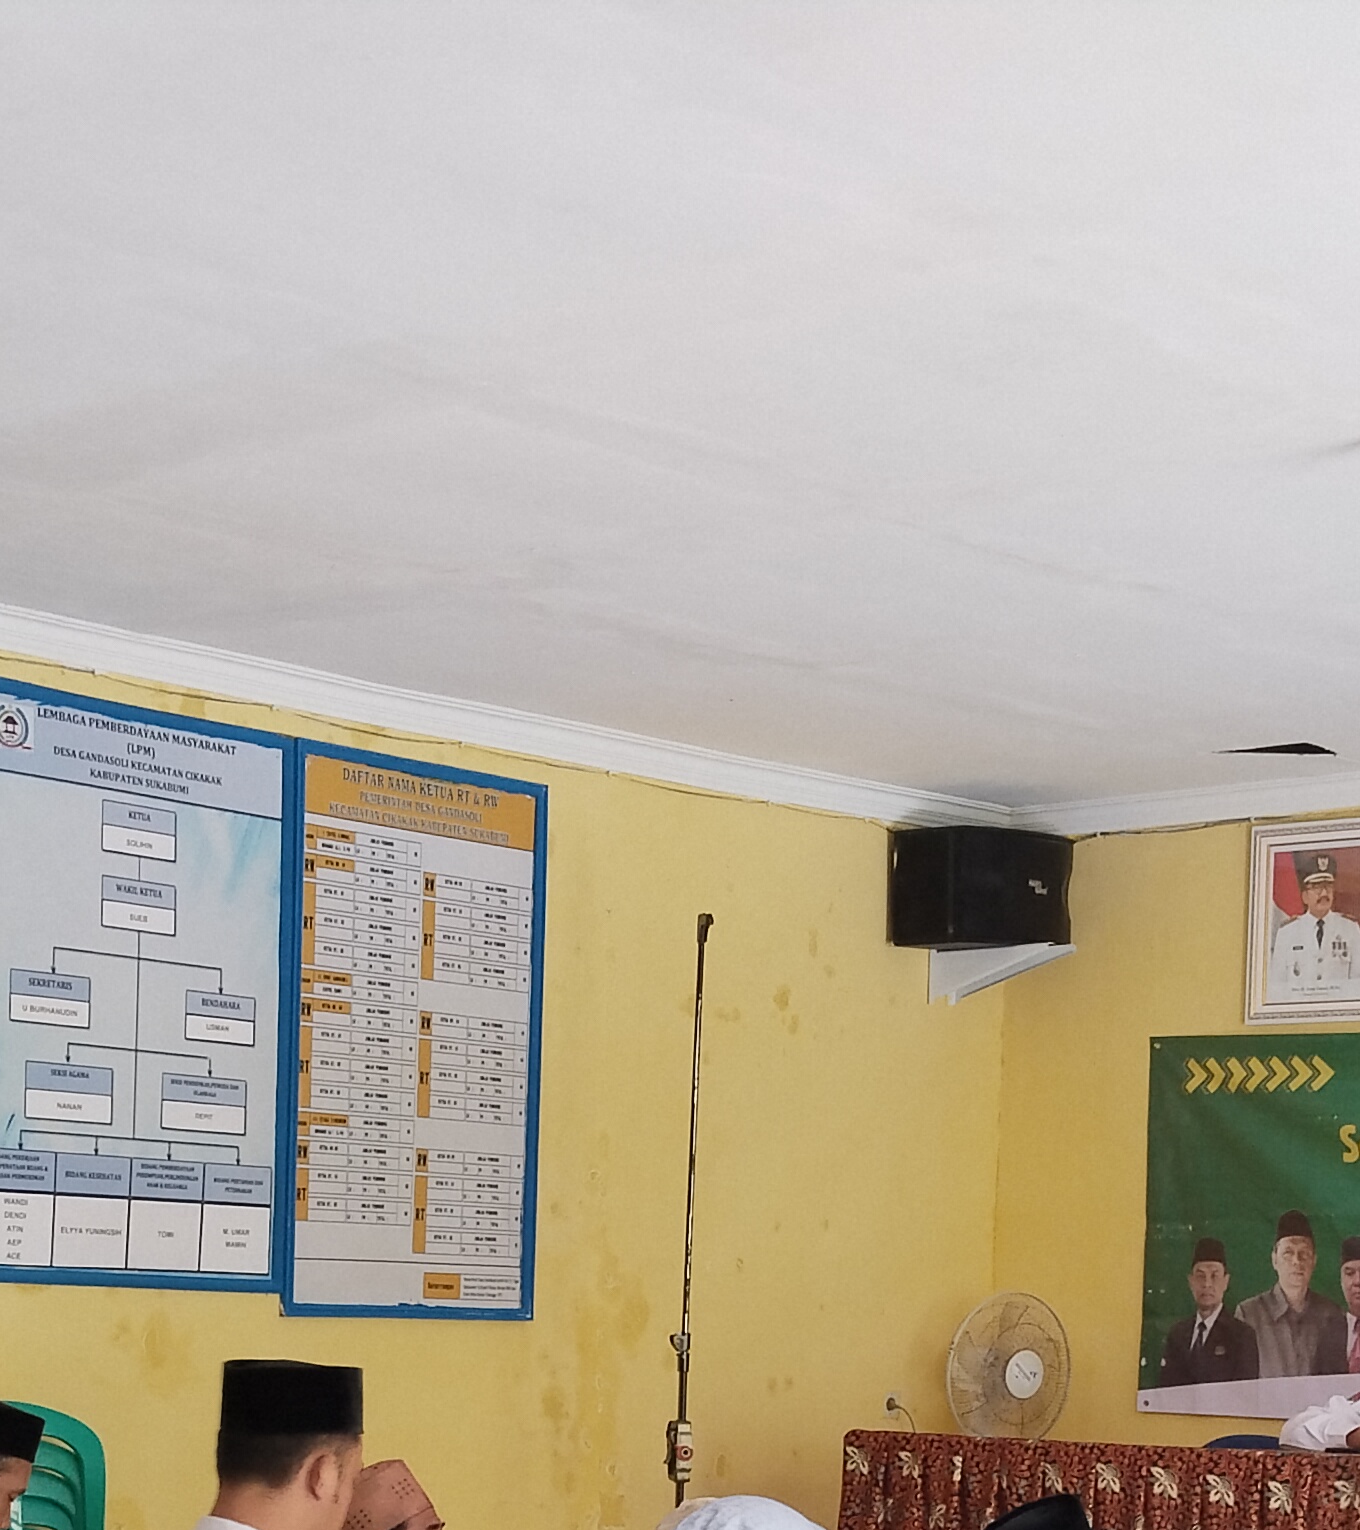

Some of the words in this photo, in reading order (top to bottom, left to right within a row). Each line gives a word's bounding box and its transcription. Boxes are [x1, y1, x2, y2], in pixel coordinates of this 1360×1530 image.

[37, 707, 87, 727] LEMBAGA
[88, 717, 170, 742] PEMBERDAYAAN
[172, 733, 237, 756] MASYARAKAT
[126, 743, 156, 760] (LPM)
[53, 745, 77, 759] DESA
[78, 750, 130, 769] GANDASOLI
[130, 760, 185, 778] KECAMATAN
[185, 771, 222, 786] CIKAKAK
[90, 768, 143, 787] KABUPATEN
[144, 779, 189, 795] SUKABUMI
[342, 768, 384, 788] DAFTAR
[387, 776, 416, 794] NAMA
[419, 782, 454, 802] KETUA
[457, 790, 471, 803] RT
[483, 793, 499, 808] RW
[128, 811, 151, 823] KETUA
[329, 802, 380, 823] KECAMATAN
[381, 812, 419, 829] CIKAKAK
[359, 791, 413, 811] PEMERINTAH
[415, 800, 436, 816] DESA
[437, 805, 483, 824] GANDASOLI
[116, 884, 138, 896] WAKIL
[139, 887, 163, 899] KETUA
[28, 977, 73, 991] SEKRETARIS
